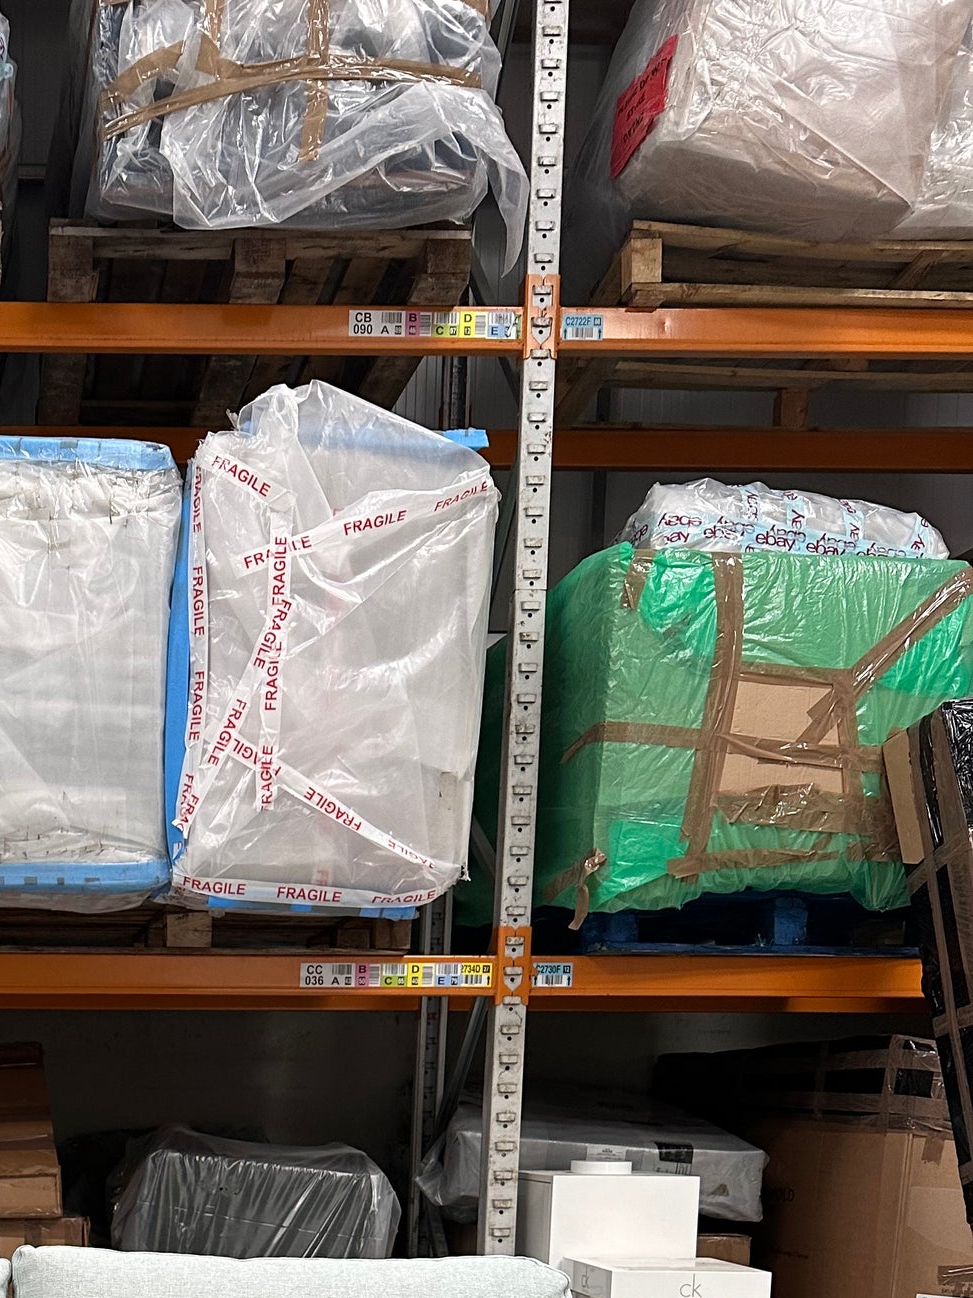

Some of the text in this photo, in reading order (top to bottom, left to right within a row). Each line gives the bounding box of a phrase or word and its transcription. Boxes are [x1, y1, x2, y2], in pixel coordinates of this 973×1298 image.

[355, 312, 372, 323] CB
[409, 313, 417, 322] B
[464, 314, 472, 323] D
[565, 316, 592, 326] C2722F
[353, 323, 373, 334] 090
[381, 325, 389, 334] A
[435, 326, 444, 335] C
[491, 326, 499, 335] E
[211, 455, 271, 497] FRAGILE
[433, 480, 488, 513] FRAGILE
[343, 509, 408, 536] FRAGILE
[755, 531, 796, 552] ebay
[271, 536, 287, 606] FRAGILE
[192, 566, 205, 636] FRAGILE
[254, 599, 293, 670] FRAGILE
[264, 641, 283, 711] FRAGILE
[188, 671, 205, 741] FRAGILE
[207, 698, 248, 766] FRAGILE
[303, 787, 363, 831] FRAGILE
[183, 876, 246, 895] FRAGILE
[277, 886, 342, 902] FRAGILE
[306, 964, 323, 975] CC
[358, 965, 367, 973] B
[412, 965, 420, 973] D
[305, 975, 324, 986] 036
[331, 976, 339, 985] A
[384, 976, 393, 985] C
[438, 976, 446, 985] E
